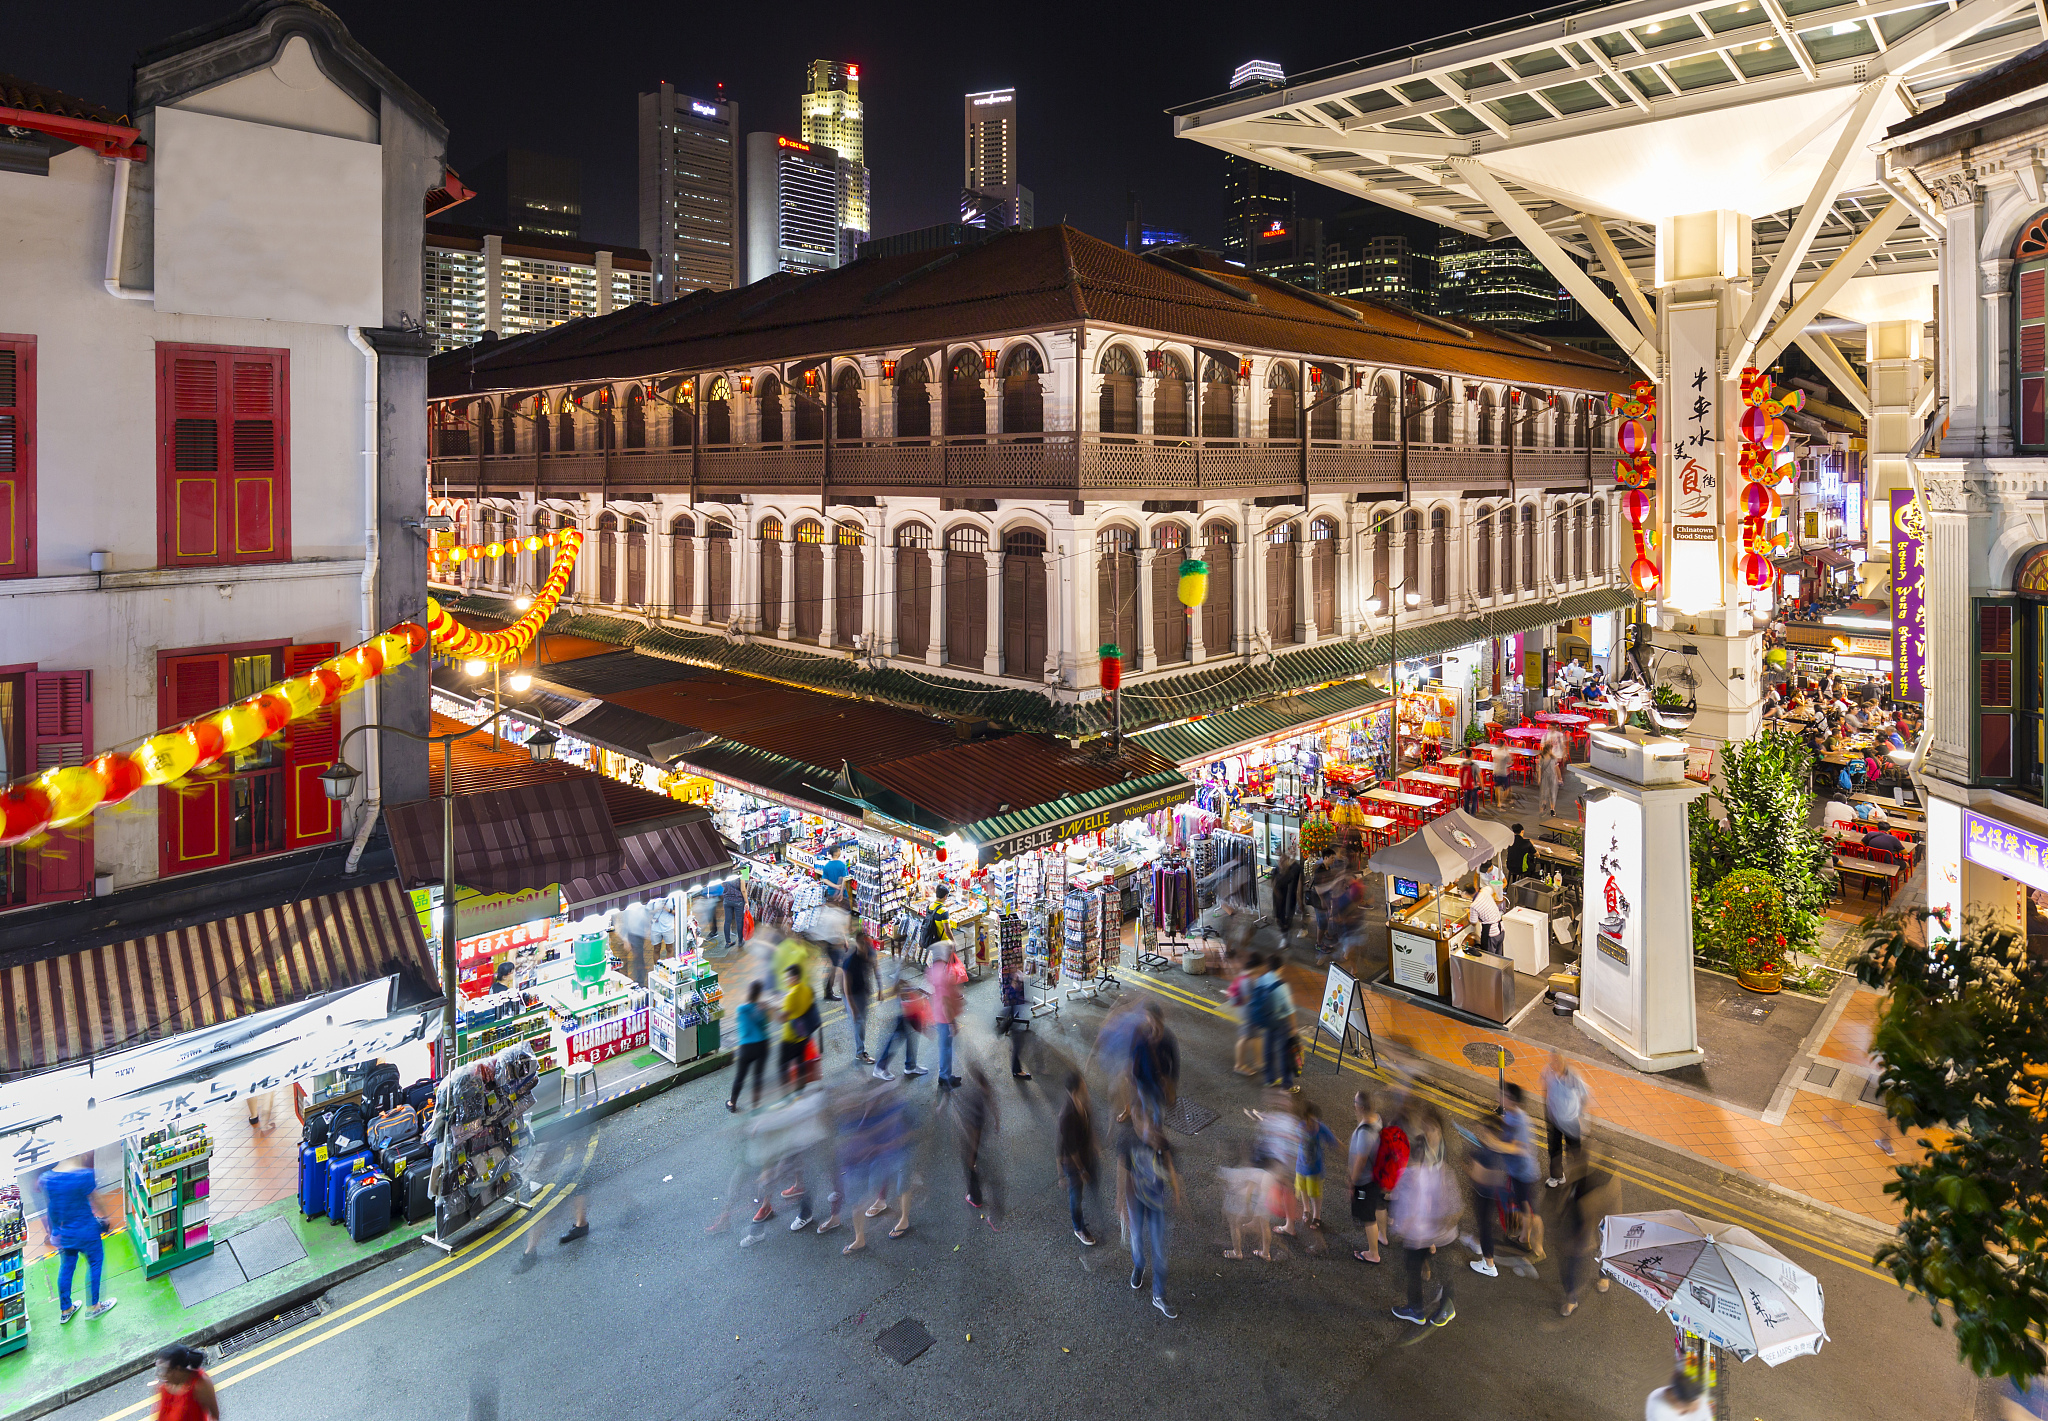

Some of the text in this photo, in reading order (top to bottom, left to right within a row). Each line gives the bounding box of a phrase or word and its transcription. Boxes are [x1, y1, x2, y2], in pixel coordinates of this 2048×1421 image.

[1676, 526, 1714, 534] Chinatown
[1895, 541, 1913, 697] Fatty Weng Restaurant
[1009, 790, 1186, 855] LESLIE JAVELLE Wholesale & Retail
[460, 889, 552, 919] WHOLESALE
[573, 1011, 647, 1055] CLEARANCE SALE
[210, 1044, 232, 1055] LACOSTE
[191, 1147, 205, 1157] $10
[1606, 1267, 1621, 1282] FREE
[1622, 1277, 1642, 1293] MAPS
[1776, 1345, 1792, 1358] MAPS
